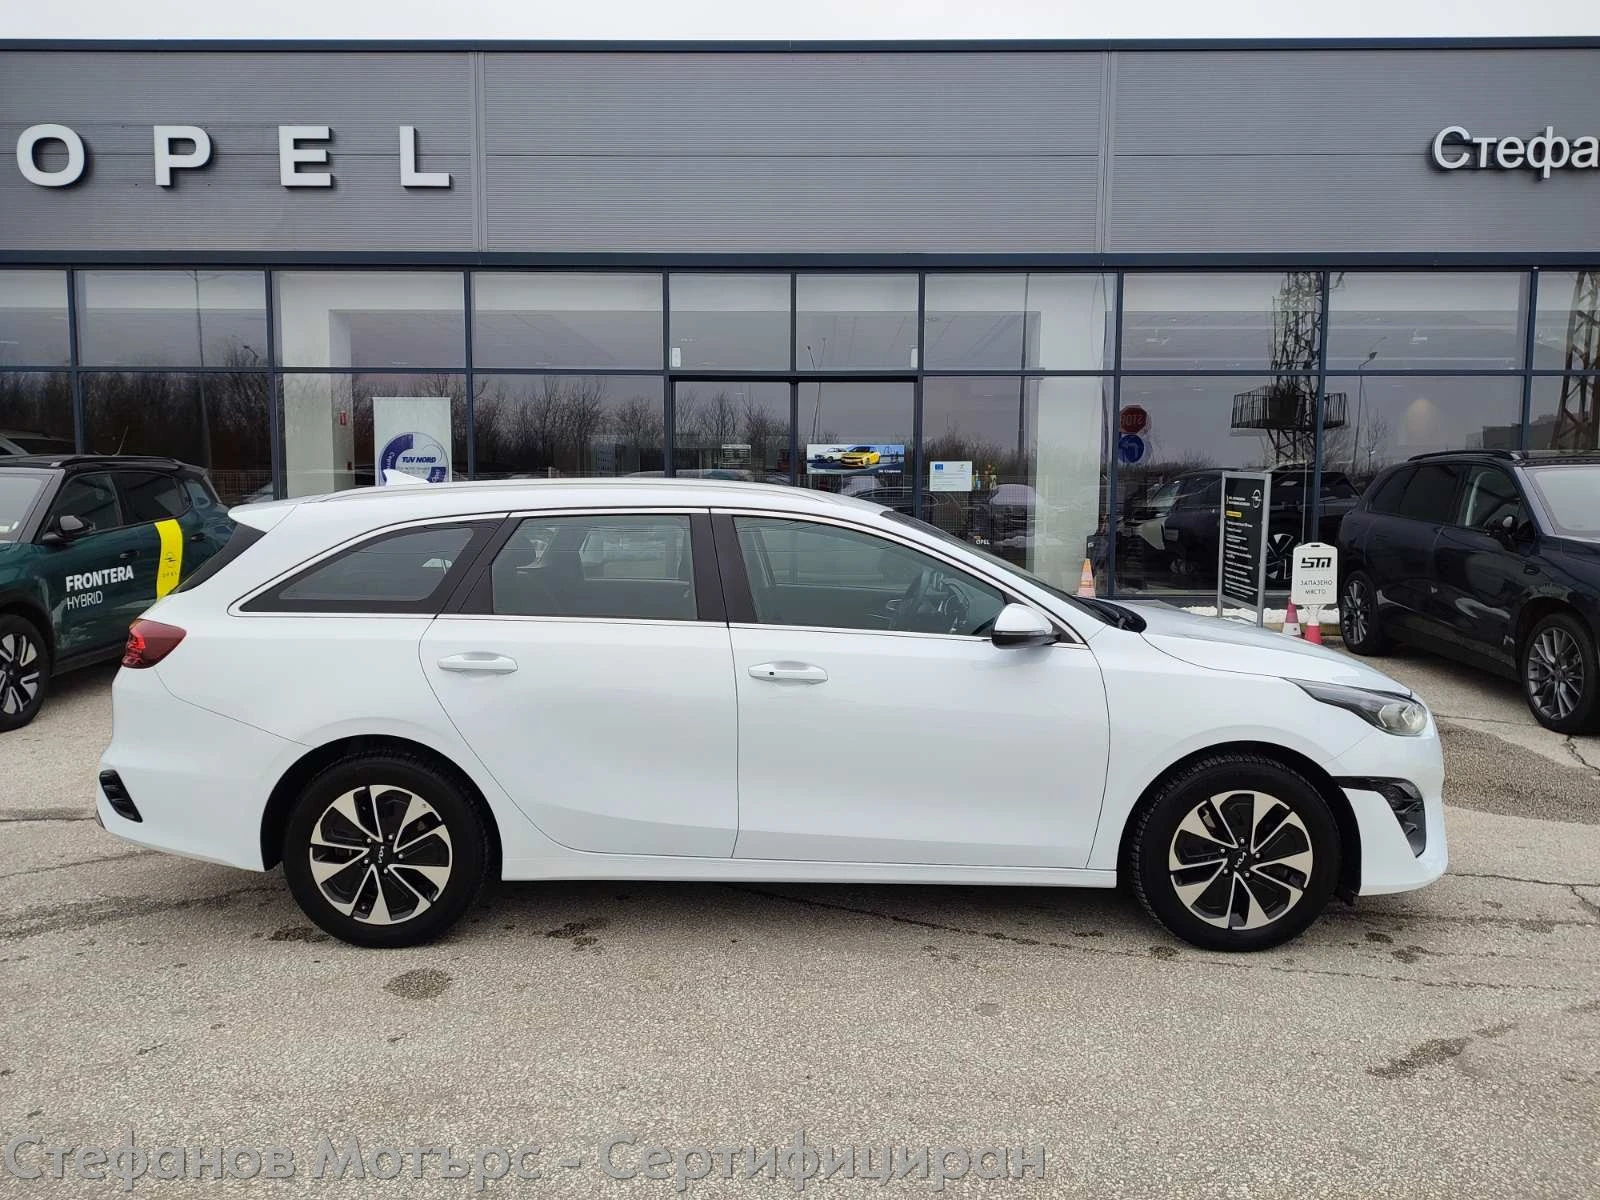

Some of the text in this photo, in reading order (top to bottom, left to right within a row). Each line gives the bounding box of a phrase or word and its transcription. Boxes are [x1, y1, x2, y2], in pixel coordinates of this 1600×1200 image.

[16, 124, 451, 188] OPEL
[1433, 125, 1600, 178] Стефа
[65, 565, 135, 592] FRONTERA
[66, 591, 103, 611] HYBRID
